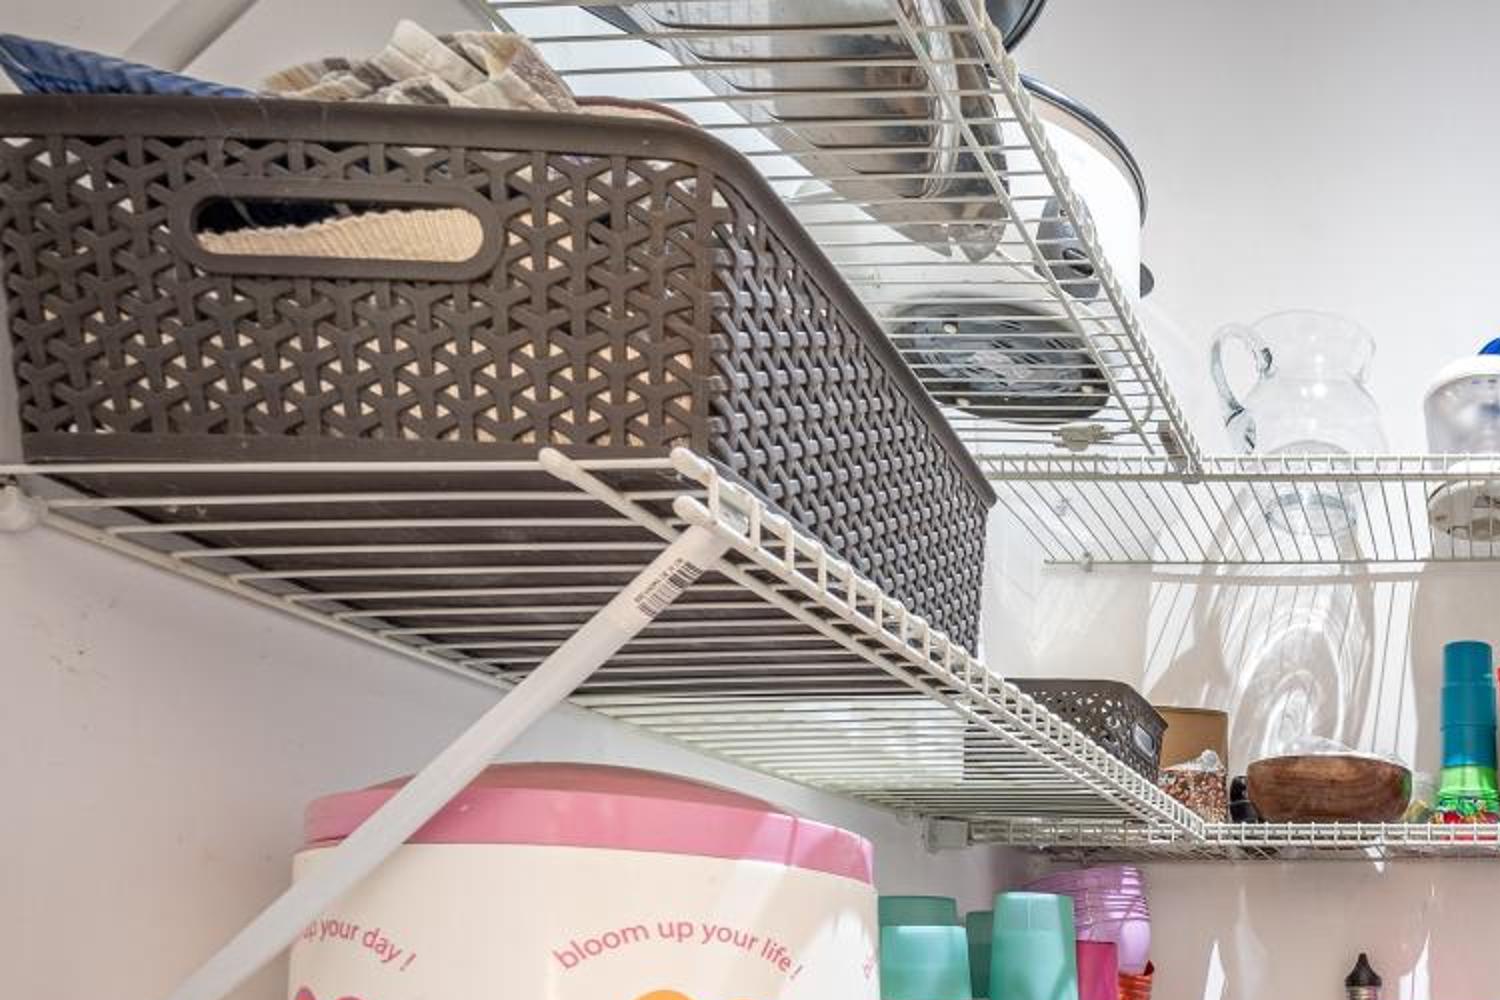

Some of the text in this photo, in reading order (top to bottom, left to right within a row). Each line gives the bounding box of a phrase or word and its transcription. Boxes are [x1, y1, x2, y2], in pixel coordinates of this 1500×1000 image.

[320, 919, 359, 942] your
[362, 927, 402, 963] day
[399, 953, 417, 972] !
[553, 920, 803, 980] bloom up your life !
